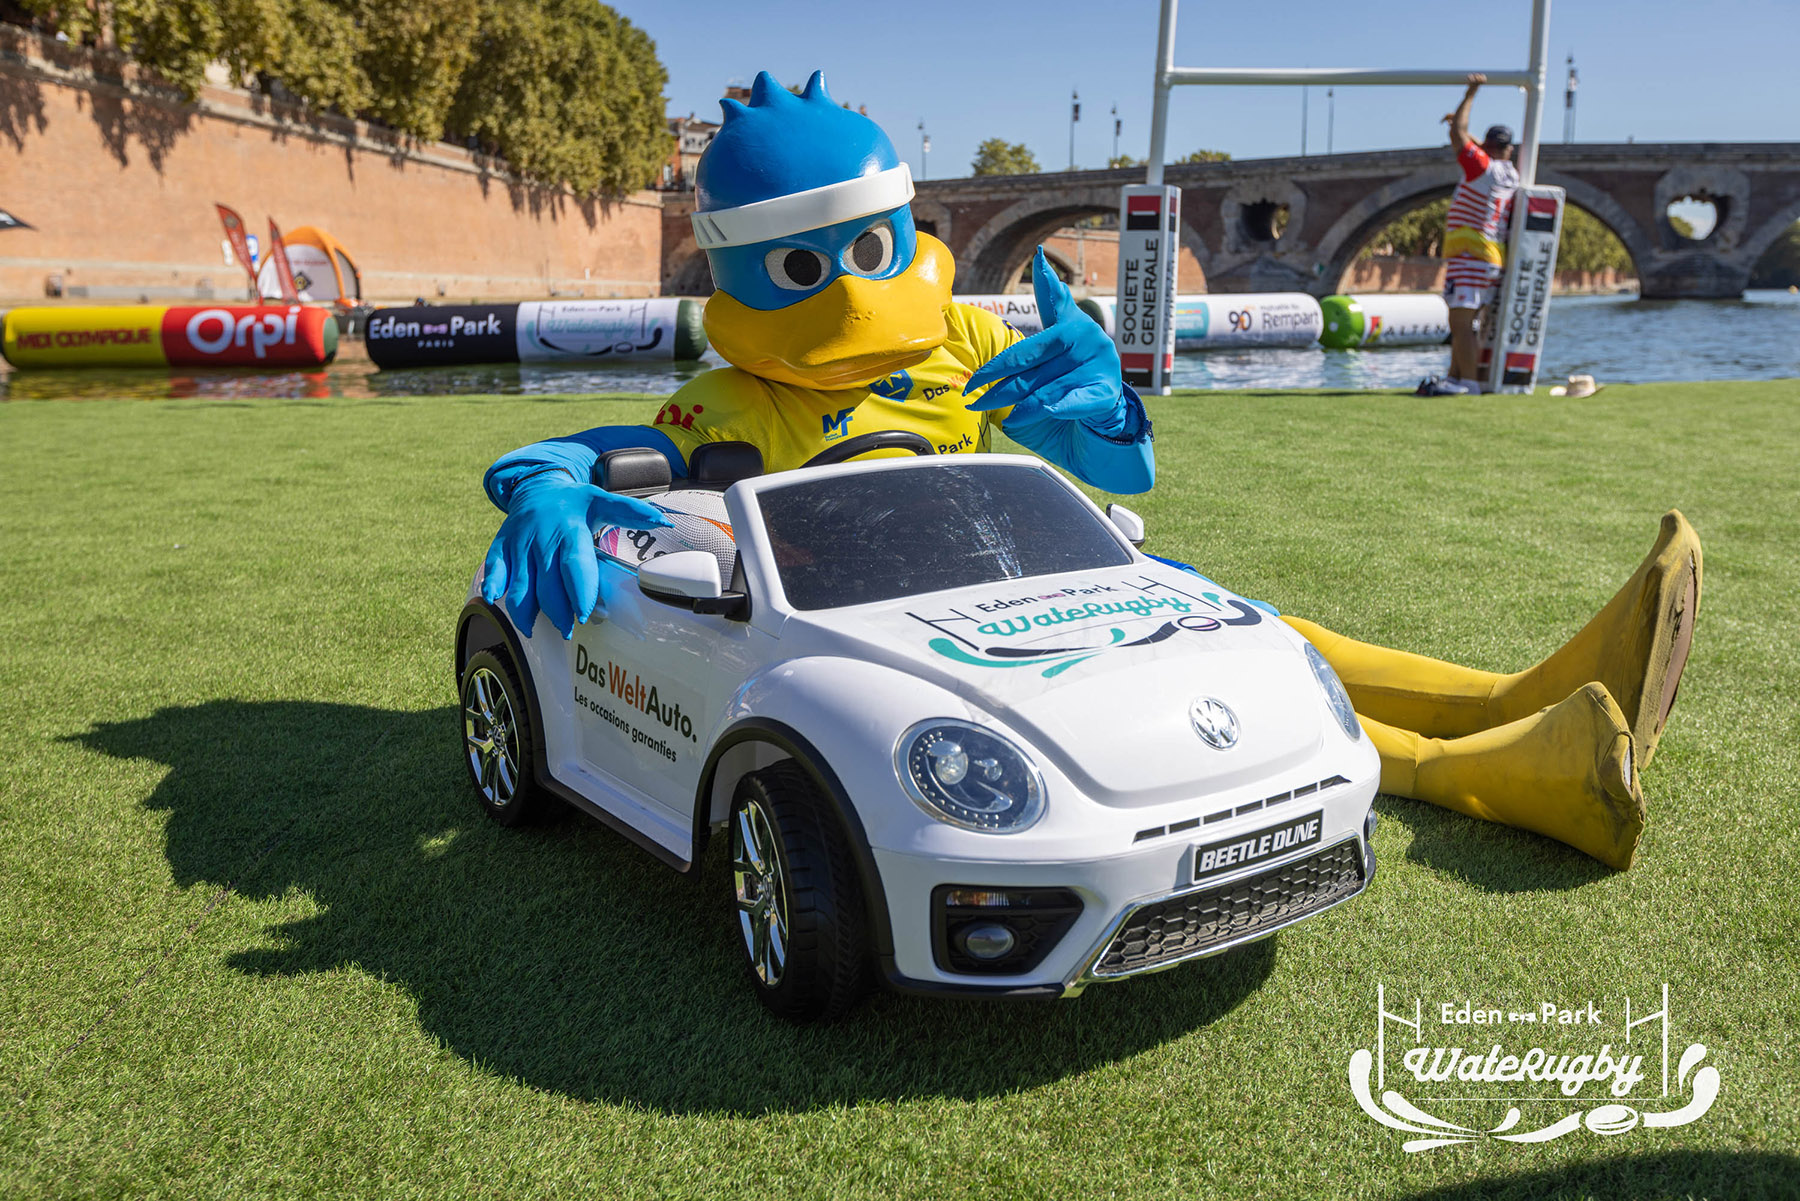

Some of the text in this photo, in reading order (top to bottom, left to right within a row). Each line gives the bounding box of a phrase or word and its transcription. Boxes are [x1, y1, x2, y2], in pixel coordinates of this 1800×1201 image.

[1122, 258, 1140, 346] SOCIETE
[1141, 237, 1160, 346] GENERALE
[186, 305, 302, 358] Orpi
[369, 313, 502, 340] Eden Park
[1228, 310, 1252, 333] 90
[1261, 311, 1320, 330] Rempart
[417, 340, 455, 349] PARIS
[922, 384, 951, 402] Das
[938, 433, 973, 455] Park
[976, 584, 1116, 613] Eden Park
[977, 594, 1193, 637] WateRugby
[575, 643, 606, 688] Das
[573, 685, 677, 763] Les occasions garanties
[1199, 818, 1320, 873] BEETLE DUNE
